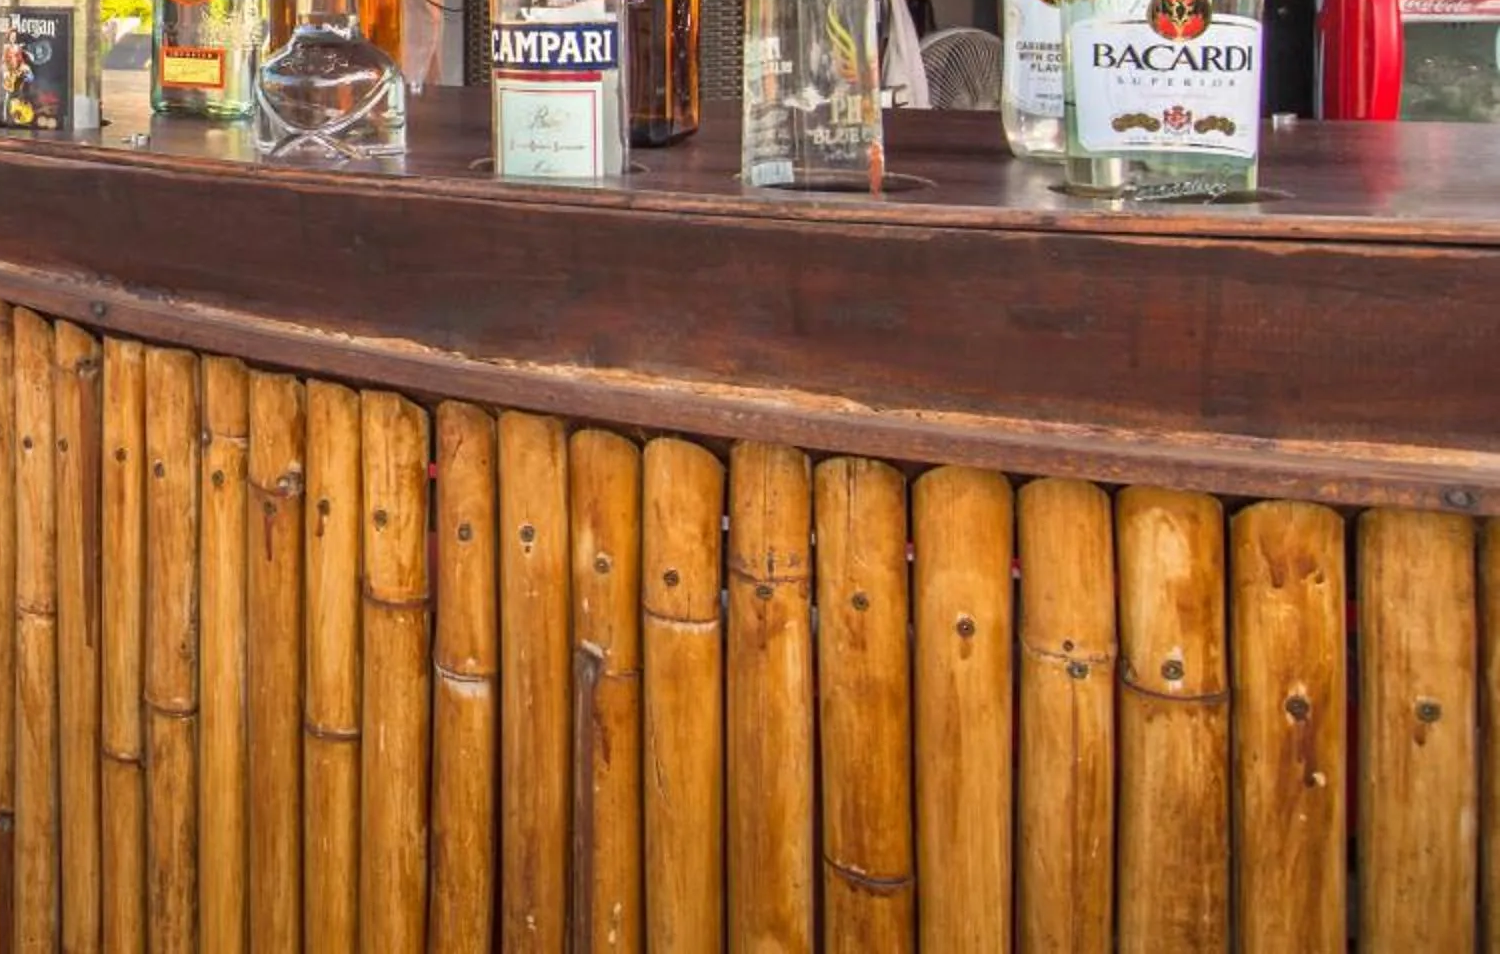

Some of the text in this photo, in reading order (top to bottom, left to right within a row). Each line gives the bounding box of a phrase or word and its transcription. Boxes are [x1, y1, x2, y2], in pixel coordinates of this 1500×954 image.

[10, 13, 56, 37] Morgan
[491, 30, 613, 64] CAMPARI
[1048, 52, 1063, 63] CO
[1093, 44, 1253, 72] BACARDI
[1030, 63, 1062, 74] FLAV
